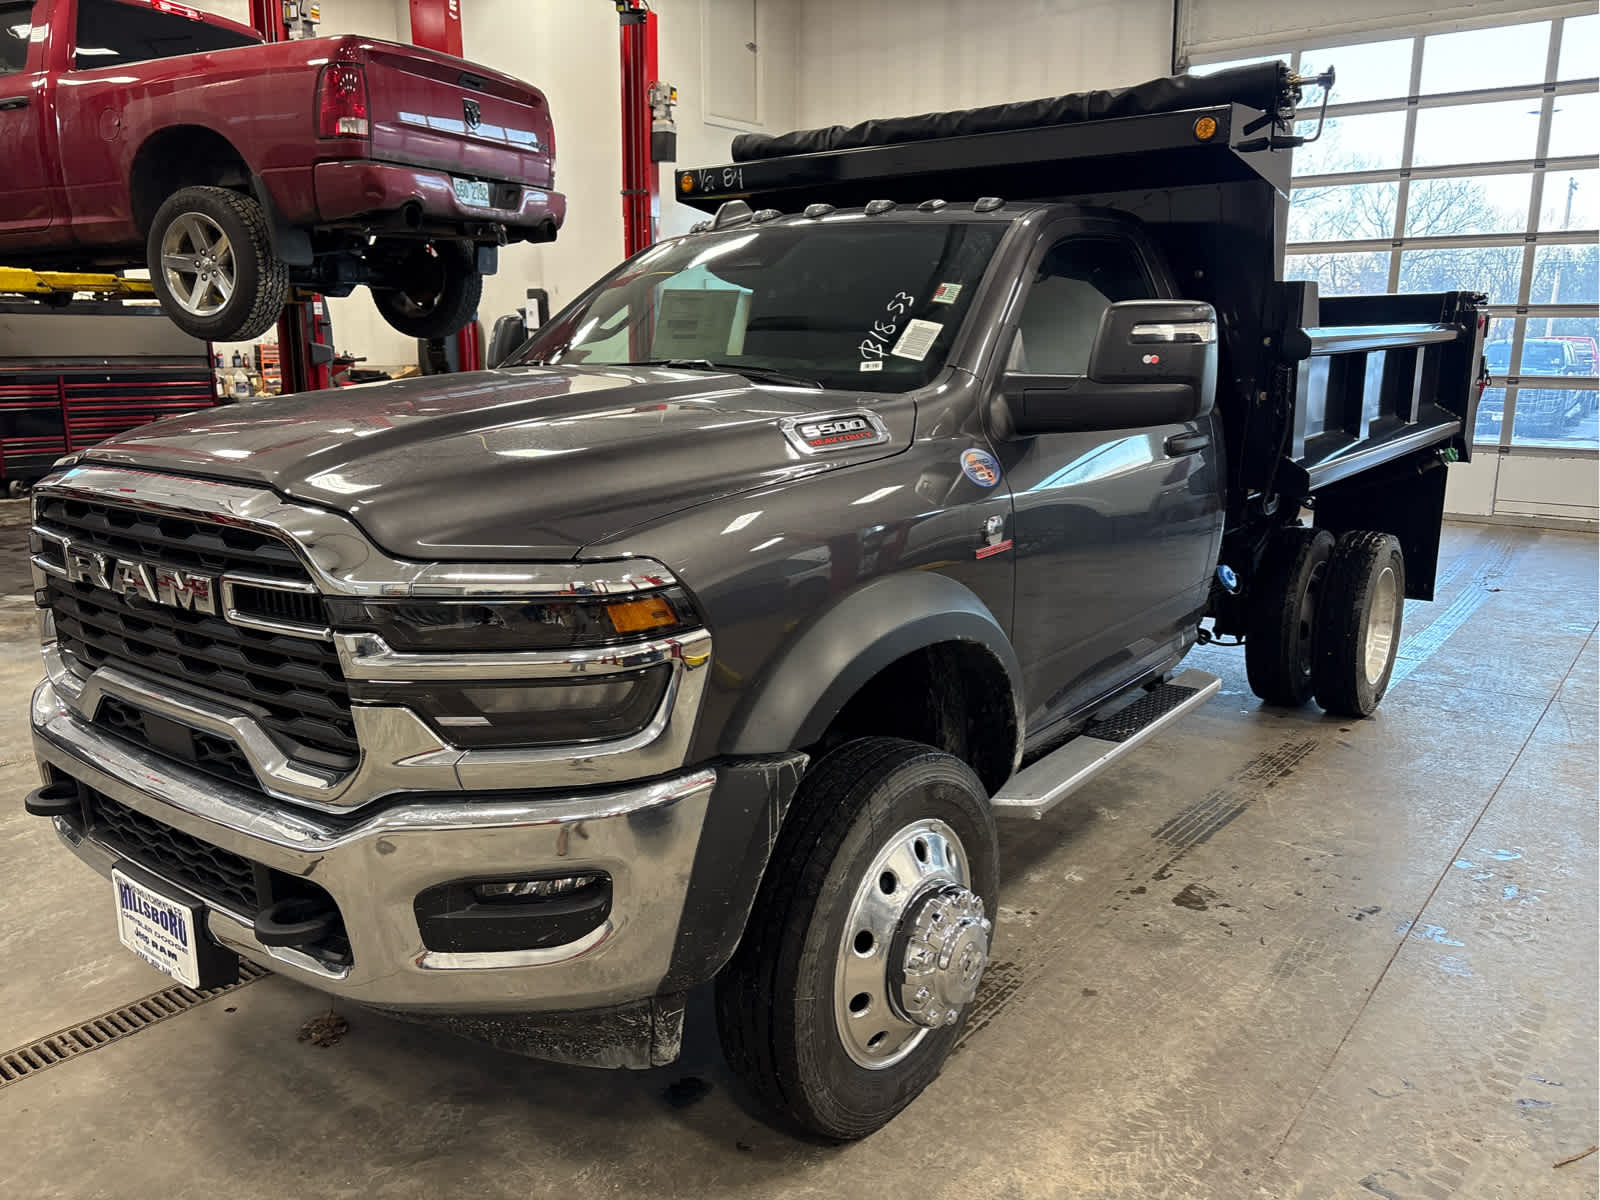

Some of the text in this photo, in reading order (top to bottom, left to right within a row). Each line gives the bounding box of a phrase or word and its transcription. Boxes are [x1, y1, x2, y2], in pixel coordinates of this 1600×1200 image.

[801, 419, 866, 438] 5500
[809, 431, 871, 447] HEAVY DUTY
[68, 550, 216, 616] RAM
[151, 940, 178, 961] RAM
